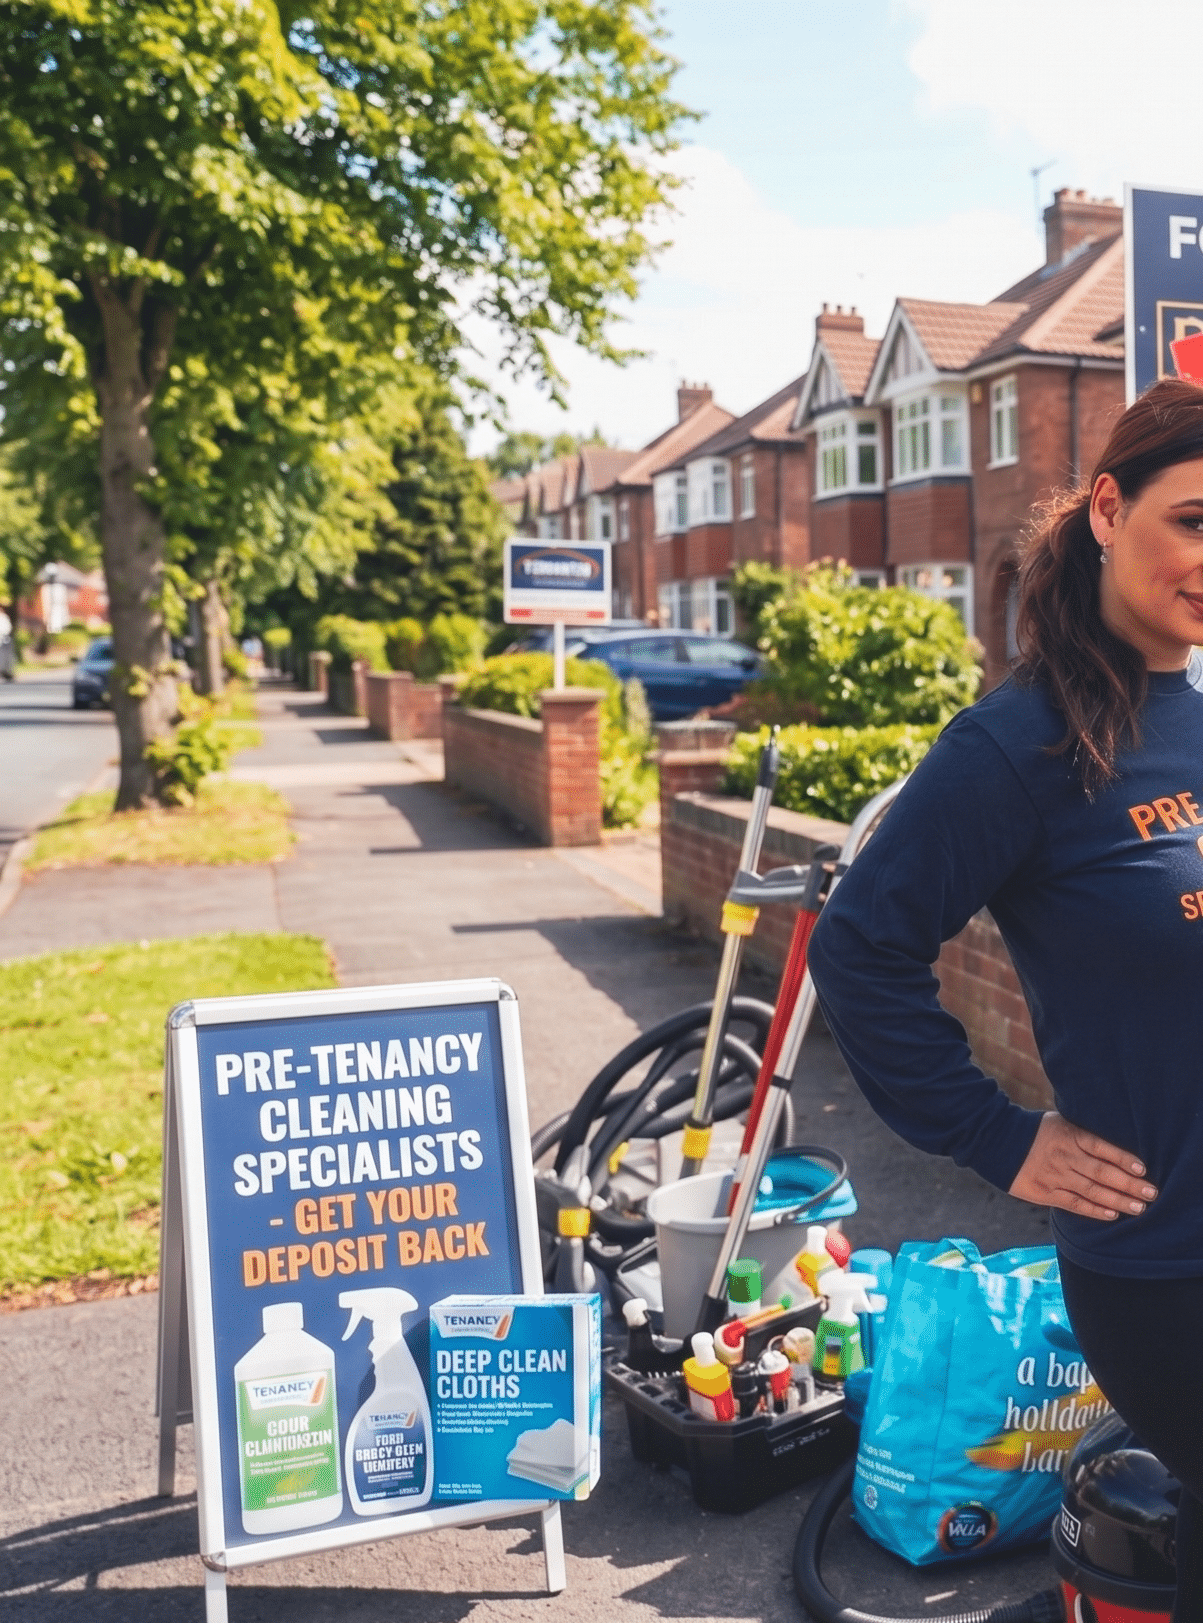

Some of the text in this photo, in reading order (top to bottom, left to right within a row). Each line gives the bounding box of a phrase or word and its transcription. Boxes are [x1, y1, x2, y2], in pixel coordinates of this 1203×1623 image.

[215, 1032, 483, 1095] PRE-TENANCY
[259, 1084, 452, 1142] CLEANING
[233, 1129, 484, 1196] SPECIALISTS
[295, 1193, 357, 1235] GET
[366, 1183, 458, 1226] YOUR
[243, 1222, 490, 1287] DEPOSIT BACK
[436, 1349, 567, 1374] DEEP CLEAN
[437, 1375, 521, 1399] CLOTHS
[1017, 1356, 1036, 1386] a
